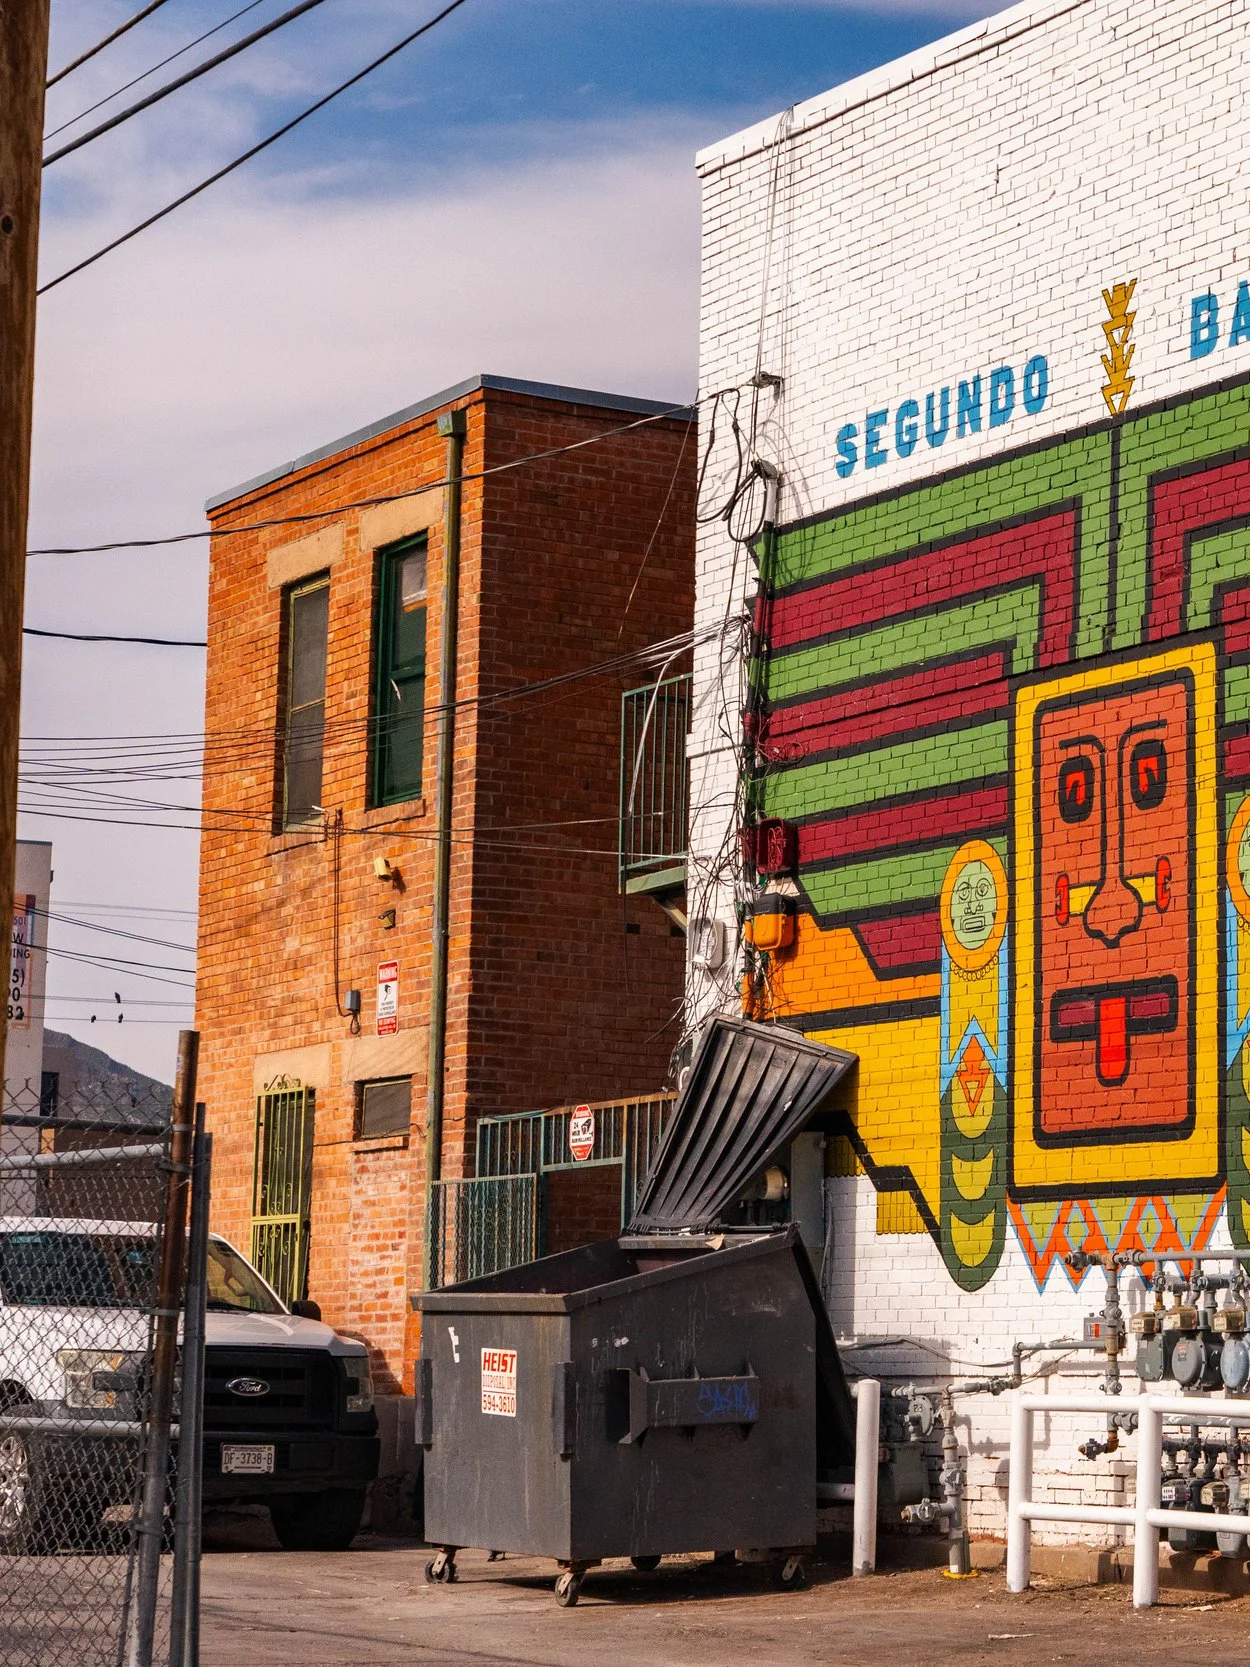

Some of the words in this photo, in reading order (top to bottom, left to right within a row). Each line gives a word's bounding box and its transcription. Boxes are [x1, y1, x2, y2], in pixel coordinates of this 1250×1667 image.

[835, 353, 1050, 478] SEGUNDO
[483, 1352, 516, 1373] HEIST
[239, 1381, 262, 1392] Ford
[482, 1393, 516, 1414] 594-3610
[223, 1452, 273, 1465] DF-3738-B
